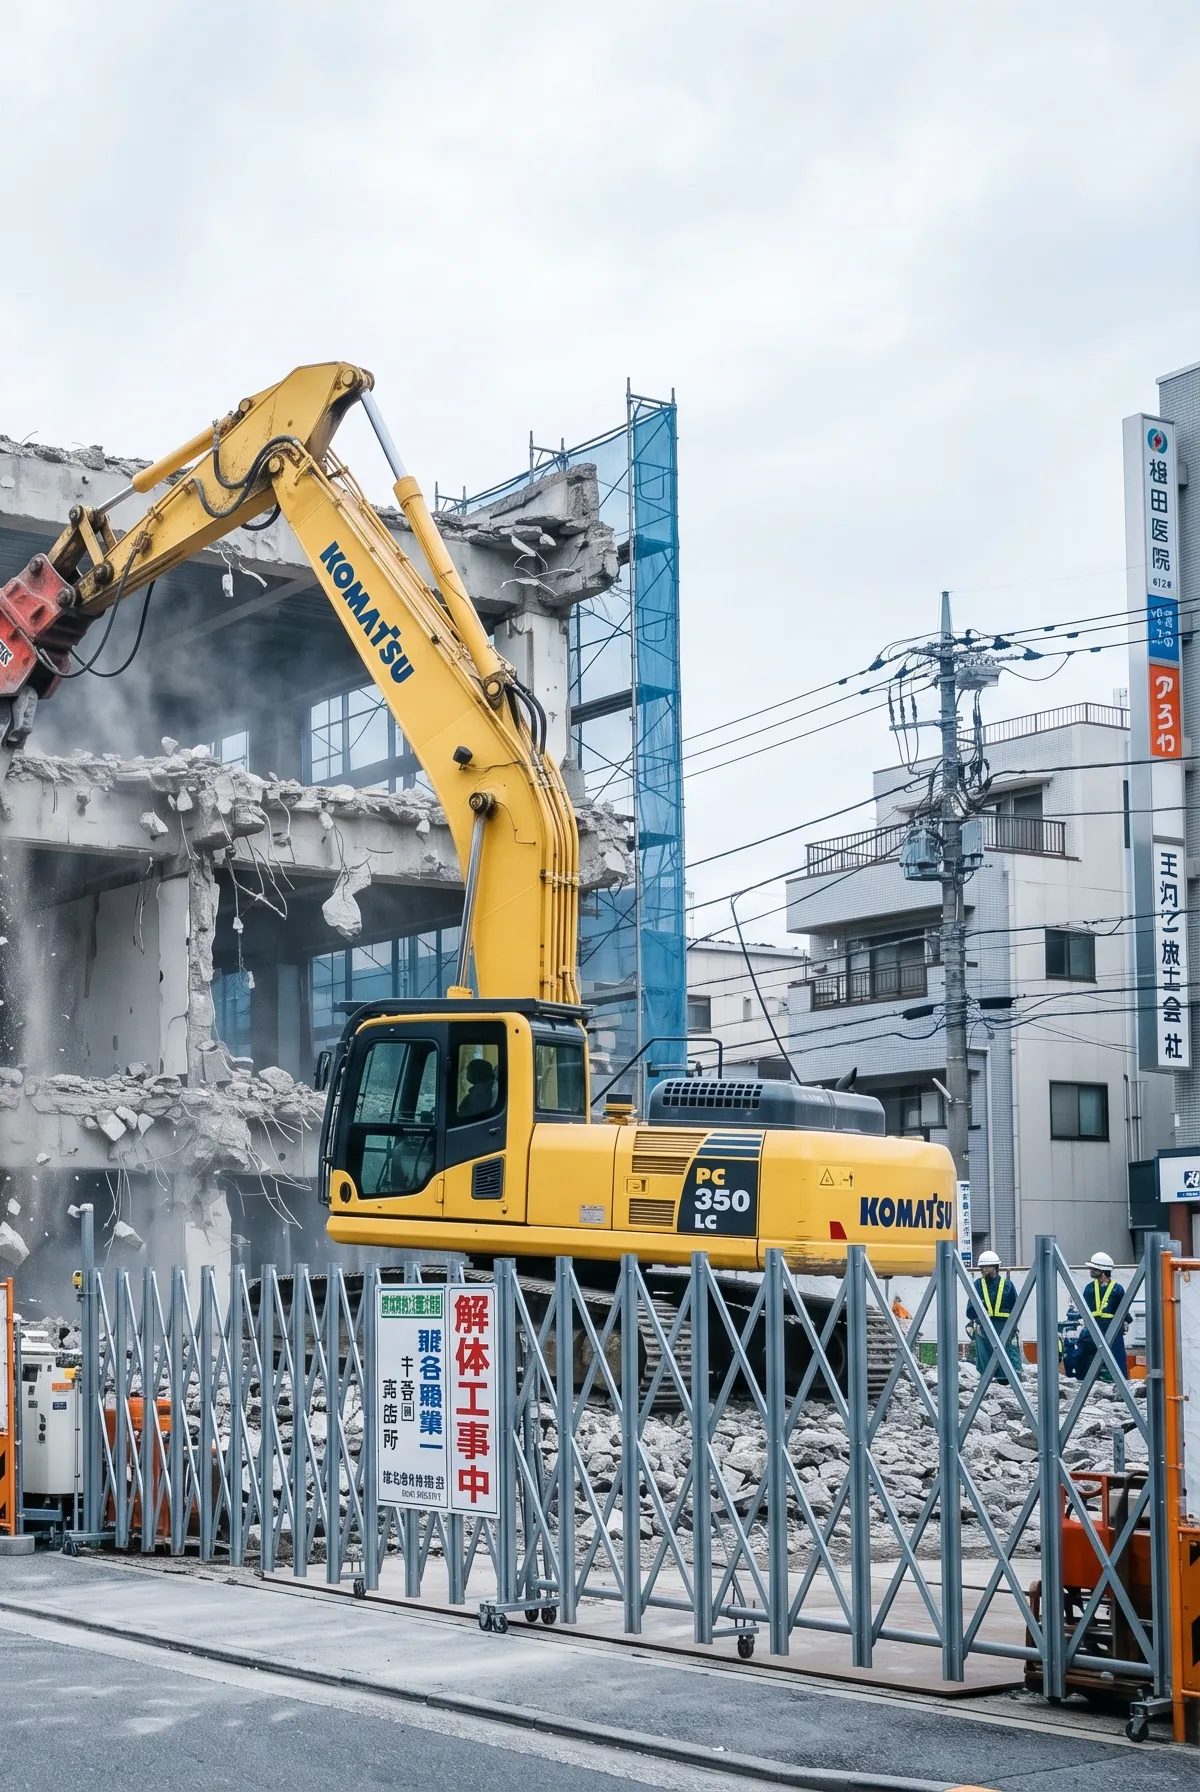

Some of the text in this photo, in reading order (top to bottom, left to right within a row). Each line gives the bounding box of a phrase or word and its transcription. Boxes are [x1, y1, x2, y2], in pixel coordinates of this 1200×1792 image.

[319, 541, 415, 683] KOMATSU
[696, 1167, 725, 1186] PC
[694, 1188, 750, 1212] 350
[860, 1193, 952, 1230] KOMATSU
[694, 1213, 717, 1230] LC
[454, 1294, 490, 1504] 解体工事中
